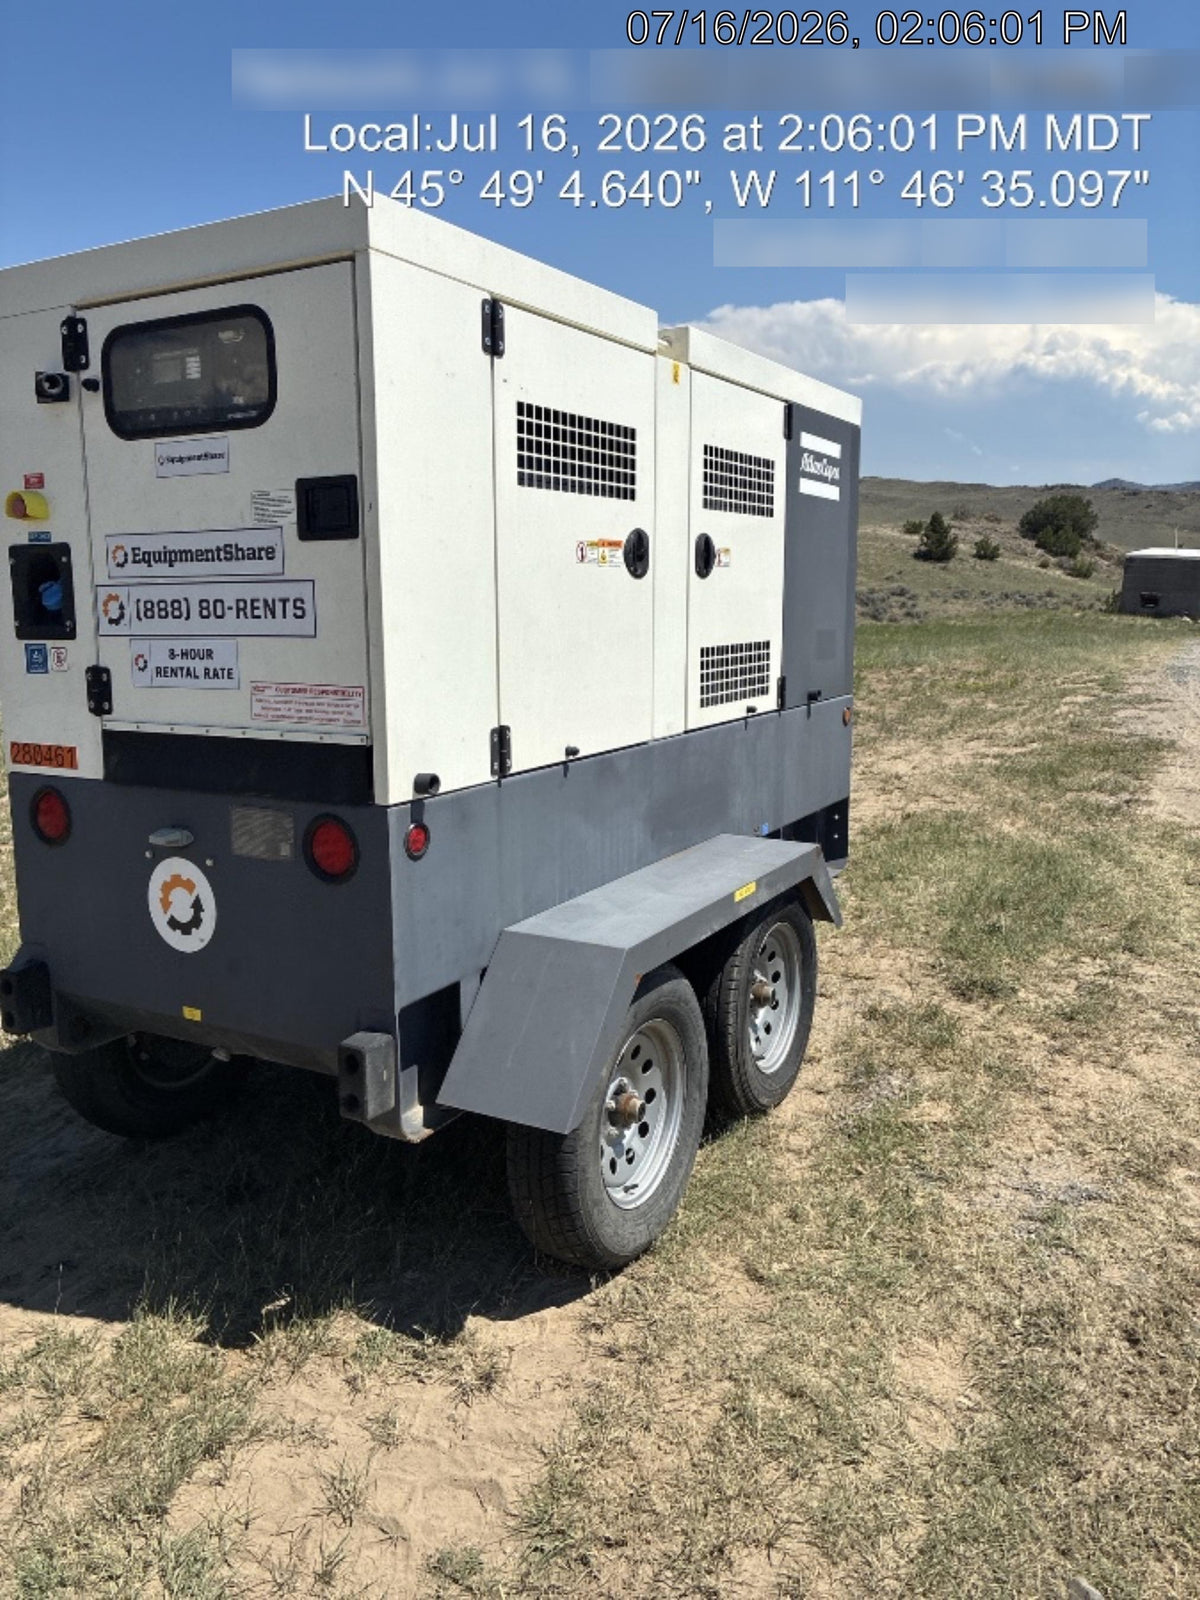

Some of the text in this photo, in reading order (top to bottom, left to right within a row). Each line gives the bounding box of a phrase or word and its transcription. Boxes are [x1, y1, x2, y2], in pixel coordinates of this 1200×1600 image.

[131, 543, 276, 568] EquipmentShare
[136, 597, 307, 621] (888) 80-RENTS
[168, 648, 214, 661] 8-HOUR
[155, 666, 234, 681] RENTAL RATE
[11, 742, 76, 769] 280461
